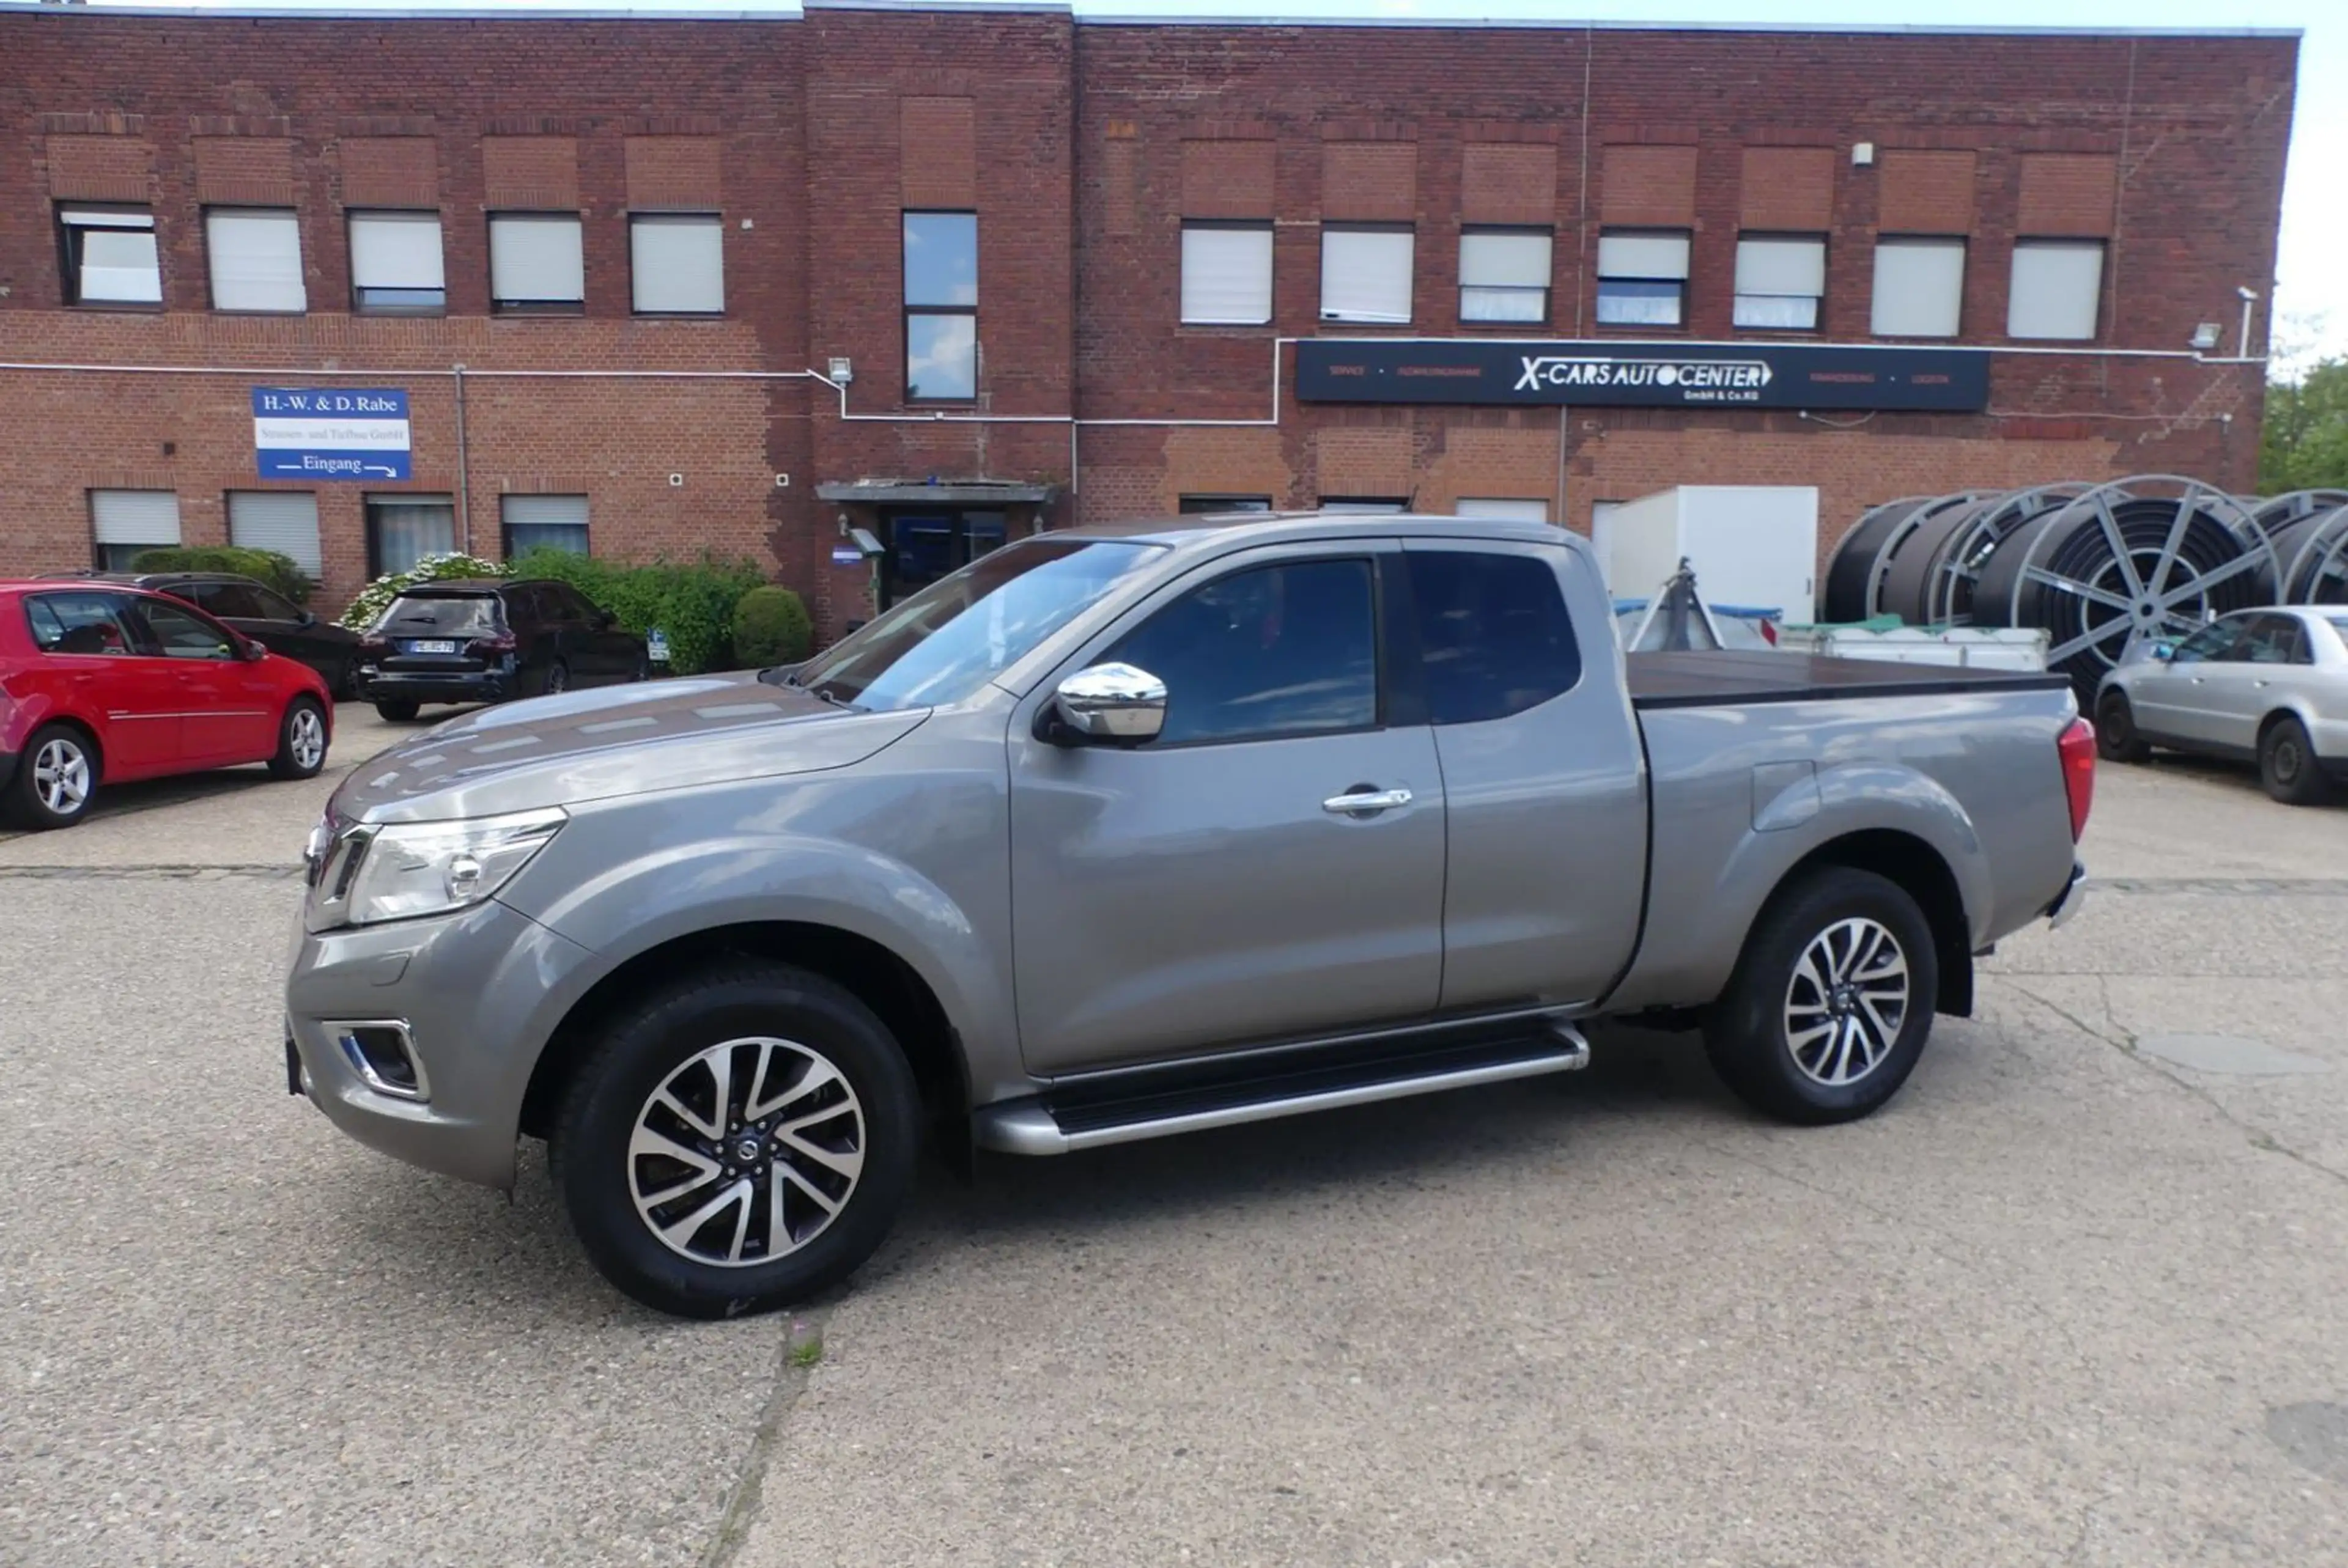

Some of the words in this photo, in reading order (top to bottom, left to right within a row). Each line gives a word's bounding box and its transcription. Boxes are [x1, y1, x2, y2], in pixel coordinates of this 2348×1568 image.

[1513, 356, 1611, 391] X-CARS
[263, 394, 311, 411] H.-W.
[316, 396, 331, 411] &
[336, 397, 355, 411] D.
[358, 397, 398, 412] Rabe
[1683, 390, 1715, 400] GmbH
[1717, 391, 1726, 400] &
[303, 455, 362, 473] Eingang
